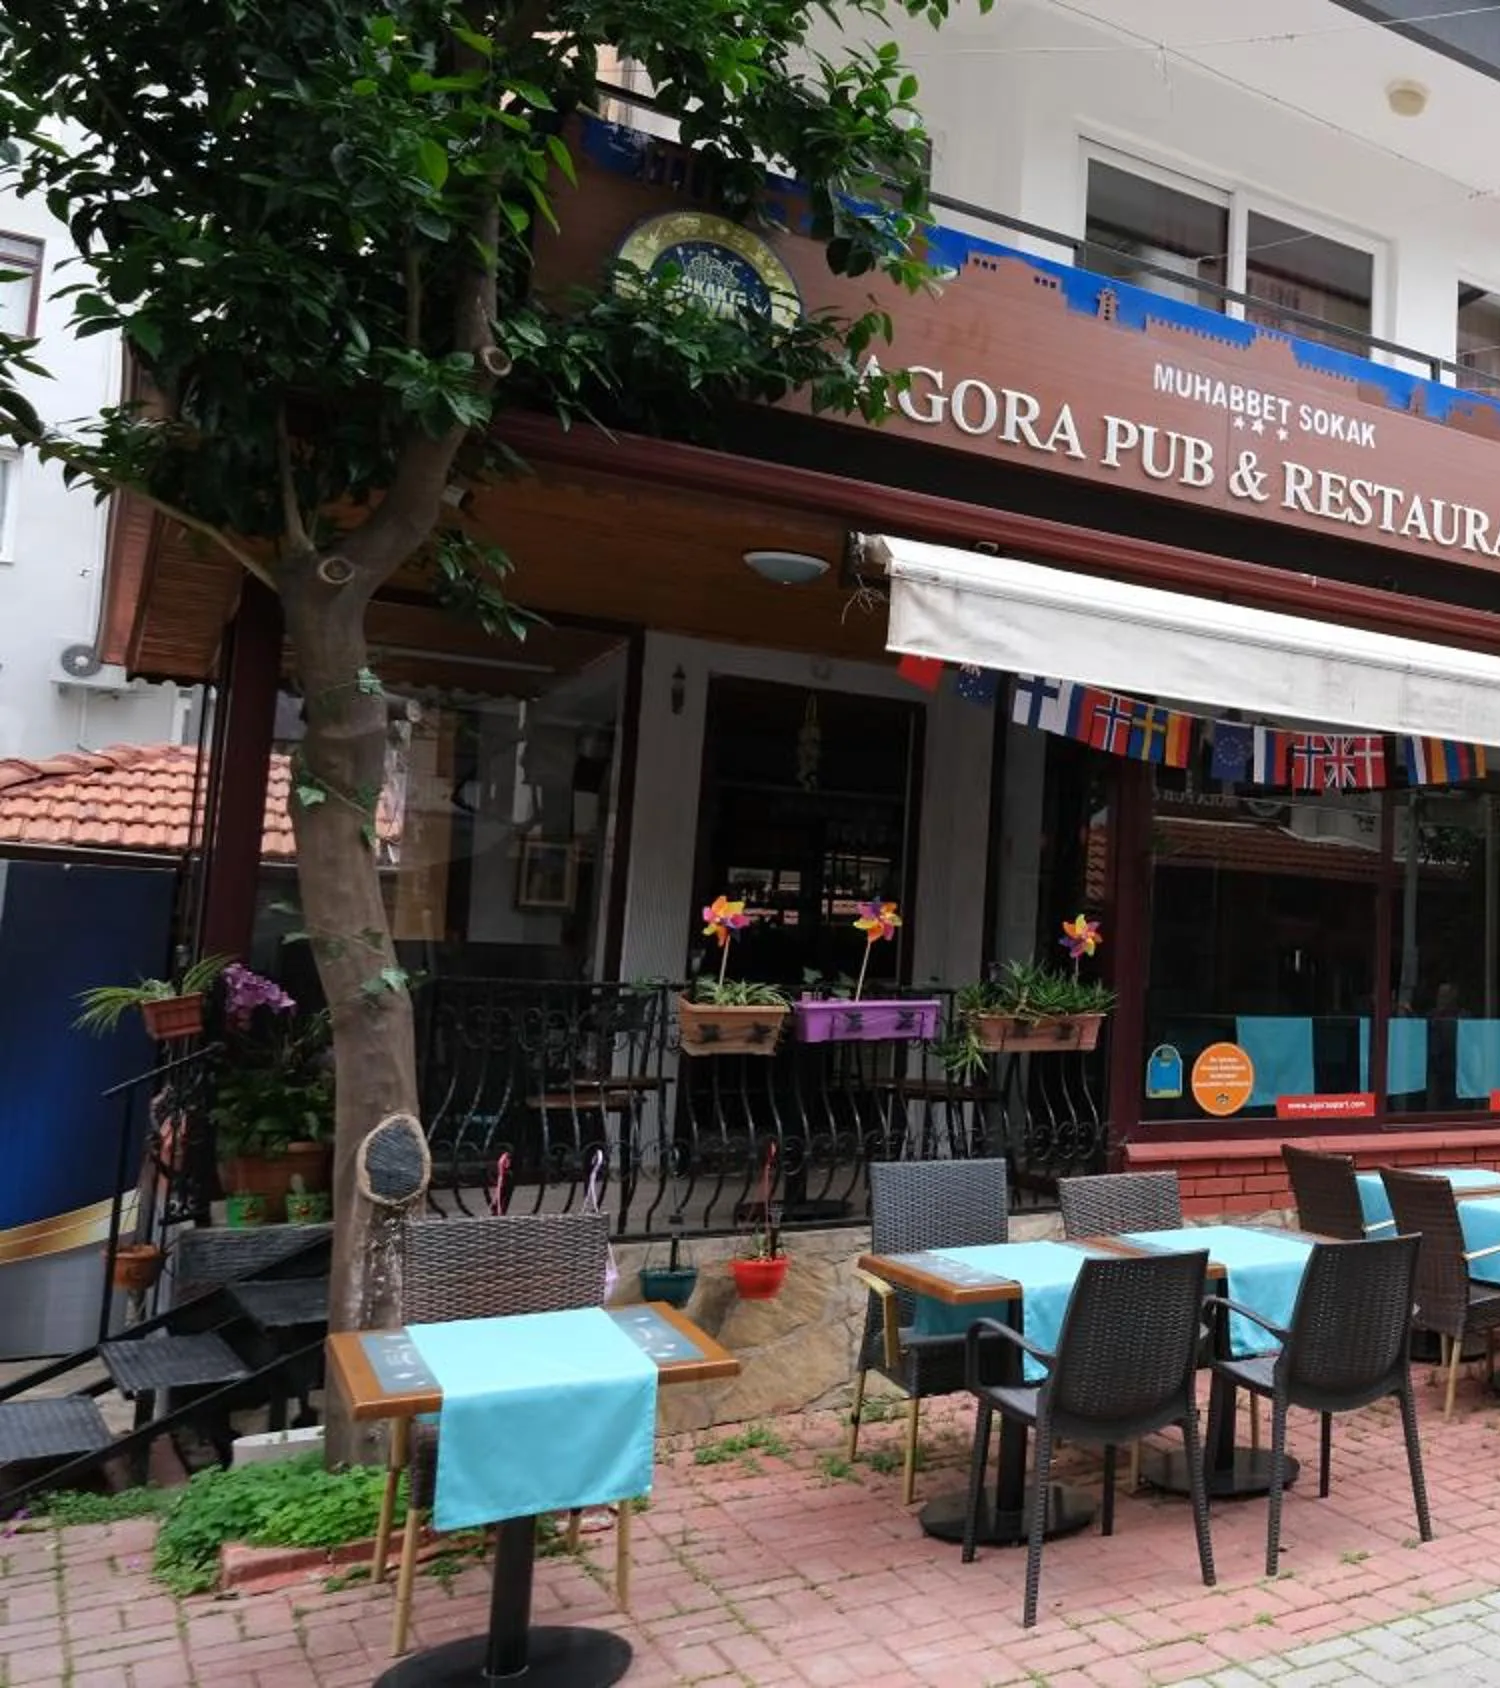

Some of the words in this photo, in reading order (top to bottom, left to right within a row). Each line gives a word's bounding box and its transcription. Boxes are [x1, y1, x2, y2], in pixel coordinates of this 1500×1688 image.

[1153, 363, 1292, 425] MUHABBET
[1299, 404, 1377, 448] SOKAK
[1100, 415, 1215, 488] PUB
[1229, 451, 1270, 501] &
